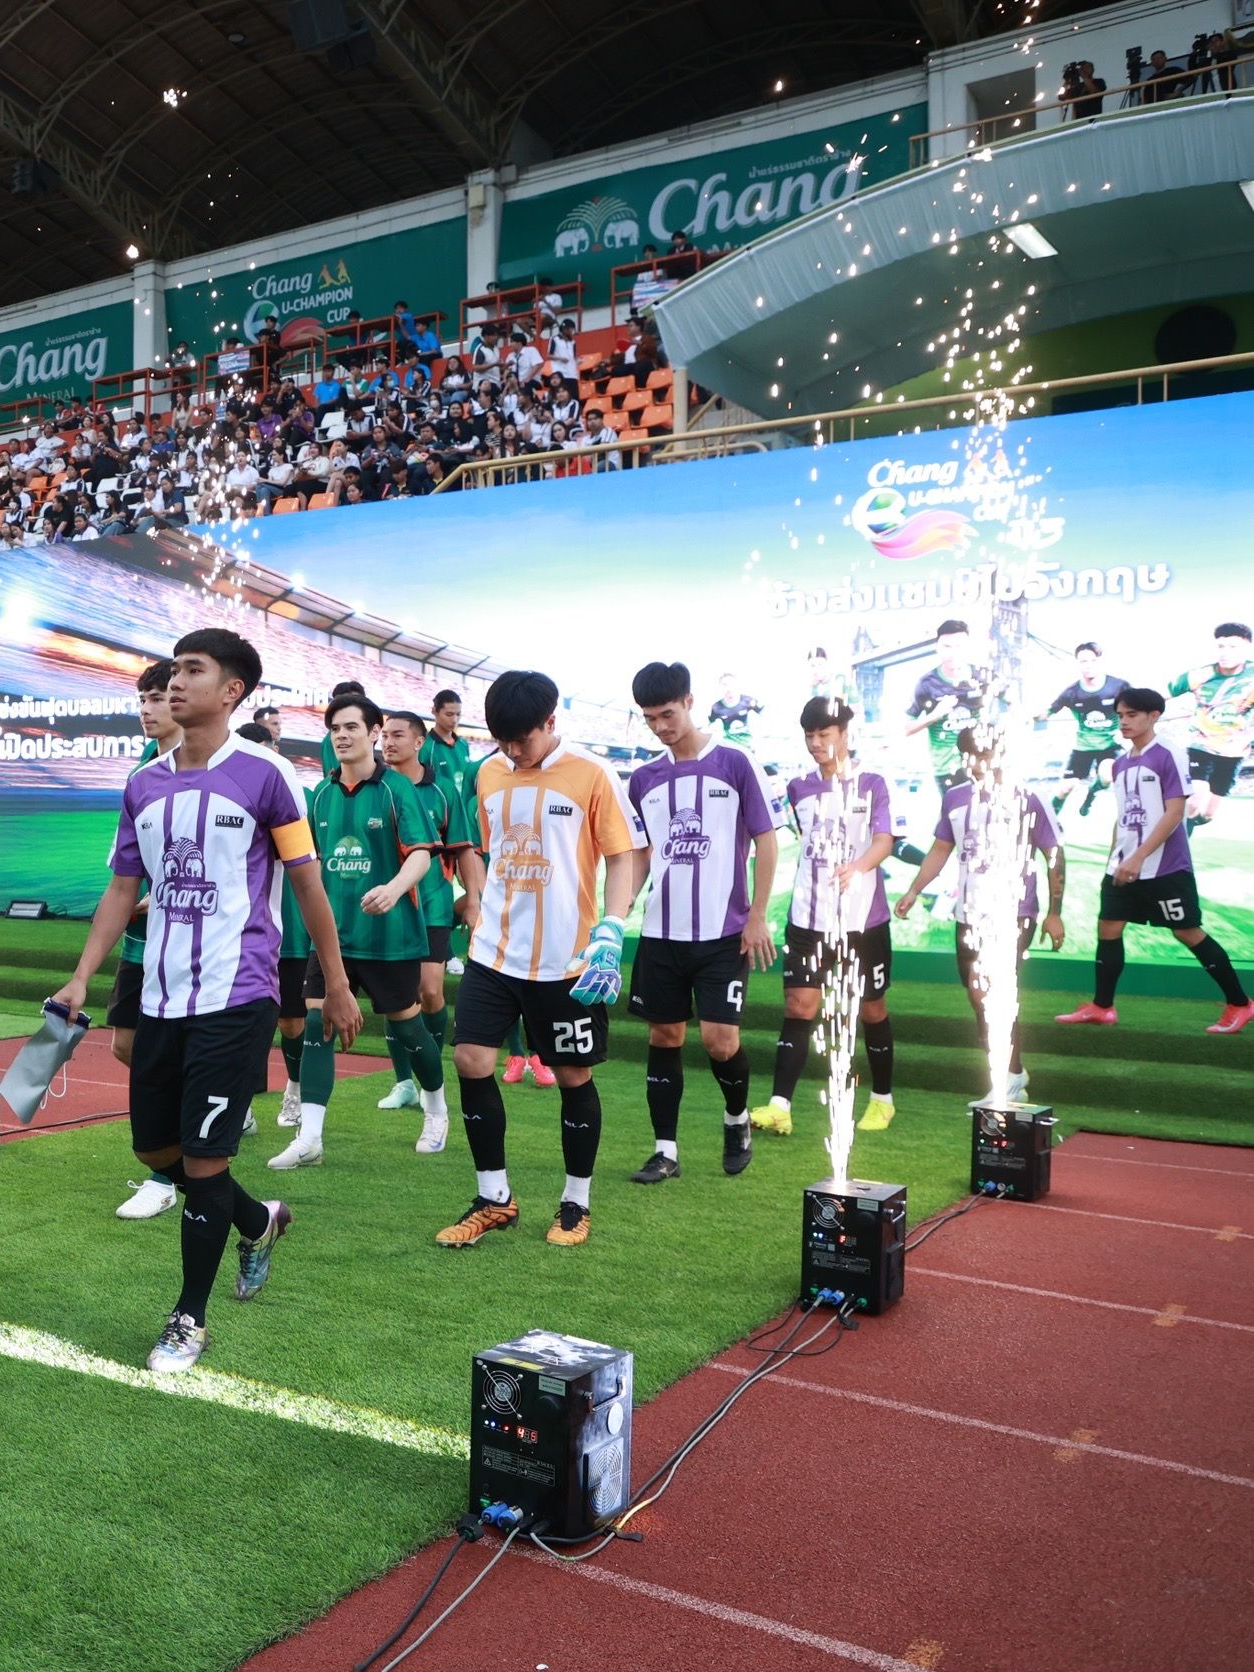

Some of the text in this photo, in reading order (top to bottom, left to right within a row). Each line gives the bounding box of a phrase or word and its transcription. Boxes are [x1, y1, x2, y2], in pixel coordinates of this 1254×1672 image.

[252, 272, 313, 299] Chang
[281, 287, 353, 314] U-CHAMPION
[327, 307, 351, 323] CUP
[867, 459, 959, 487] Chang
[216, 815, 244, 826] RBAC
[550, 805, 573, 815] RBAC
[662, 838, 711, 860] Chang
[327, 857, 372, 873] Chang
[493, 858, 554, 886] Chang
[156, 881, 218, 916] Chang
[1158, 898, 1185, 921] 15
[873, 963, 885, 989] 5
[553, 1017, 594, 1054] 25
[199, 1095, 229, 1139] 7
